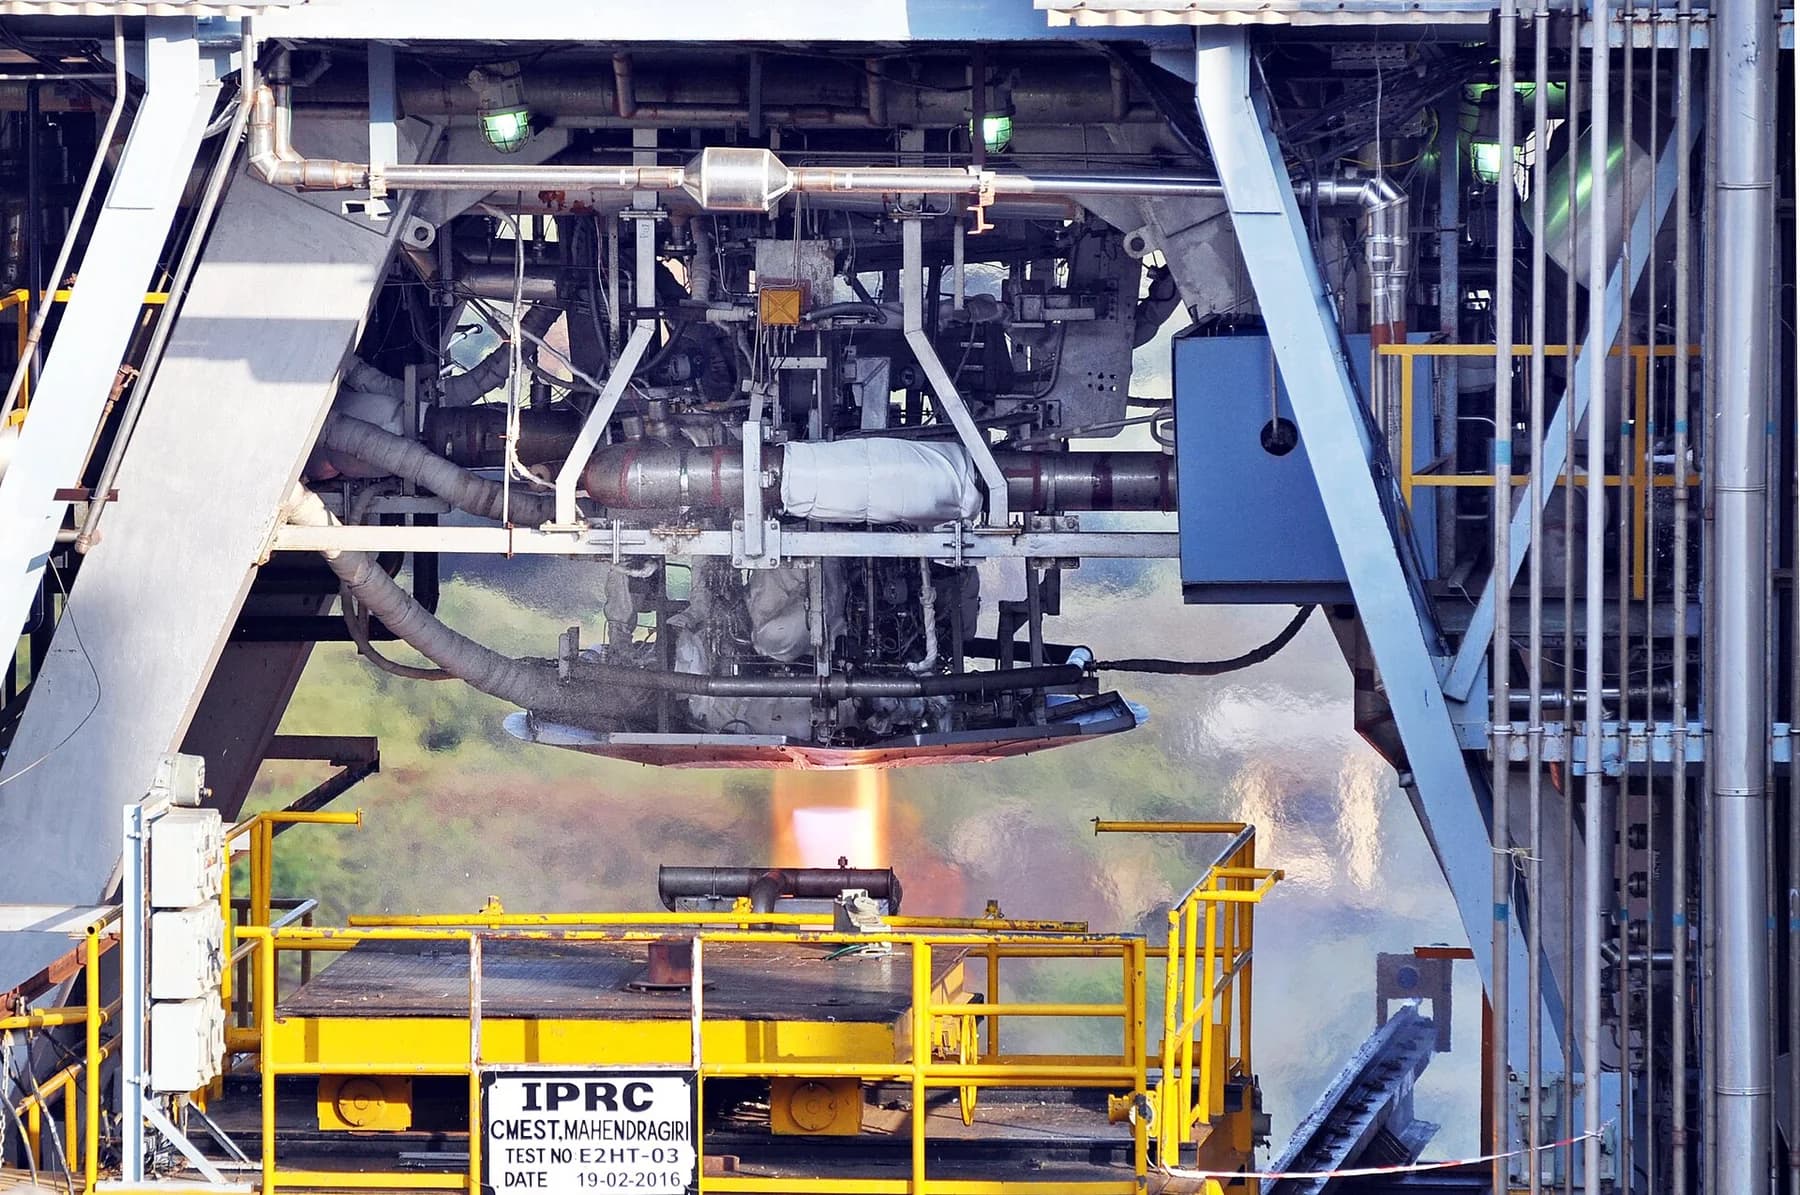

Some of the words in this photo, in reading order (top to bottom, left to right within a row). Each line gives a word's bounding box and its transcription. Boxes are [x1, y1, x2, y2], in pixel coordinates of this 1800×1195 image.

[521, 1081, 654, 1112] IPRC
[505, 1147, 546, 1164] TEST
[579, 1147, 679, 1164] E2HT-03
[504, 1171, 548, 1188] DATE
[577, 1171, 681, 1188] 19-02-2016
